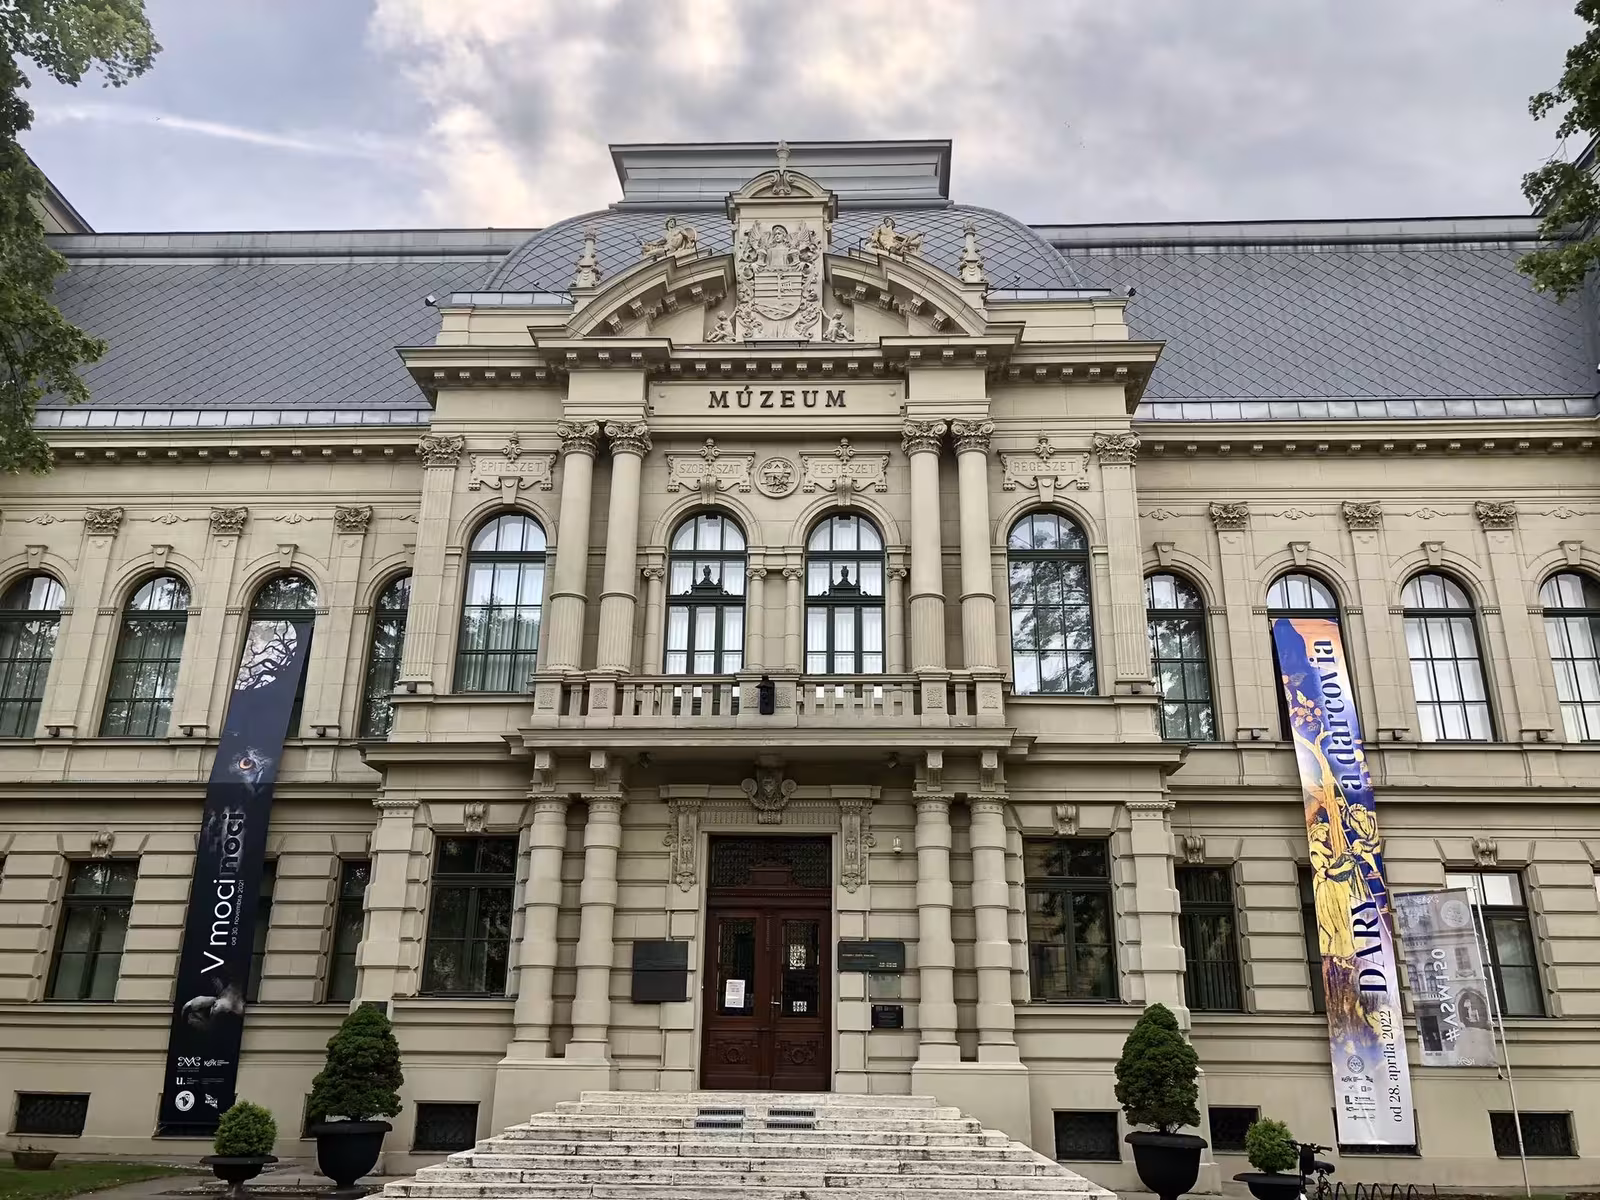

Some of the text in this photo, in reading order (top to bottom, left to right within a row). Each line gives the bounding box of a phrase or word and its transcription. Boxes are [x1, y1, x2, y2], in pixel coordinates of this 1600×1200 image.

[708, 385, 847, 408] MÚZEUM
[1309, 640, 1388, 993] DARY a darcovia
[200, 813, 245, 974] V moci noci
[231, 936, 237, 946] od
[234, 894, 243, 925] novembra
[1380, 1010, 1403, 1123] od 28. apríla 2022
